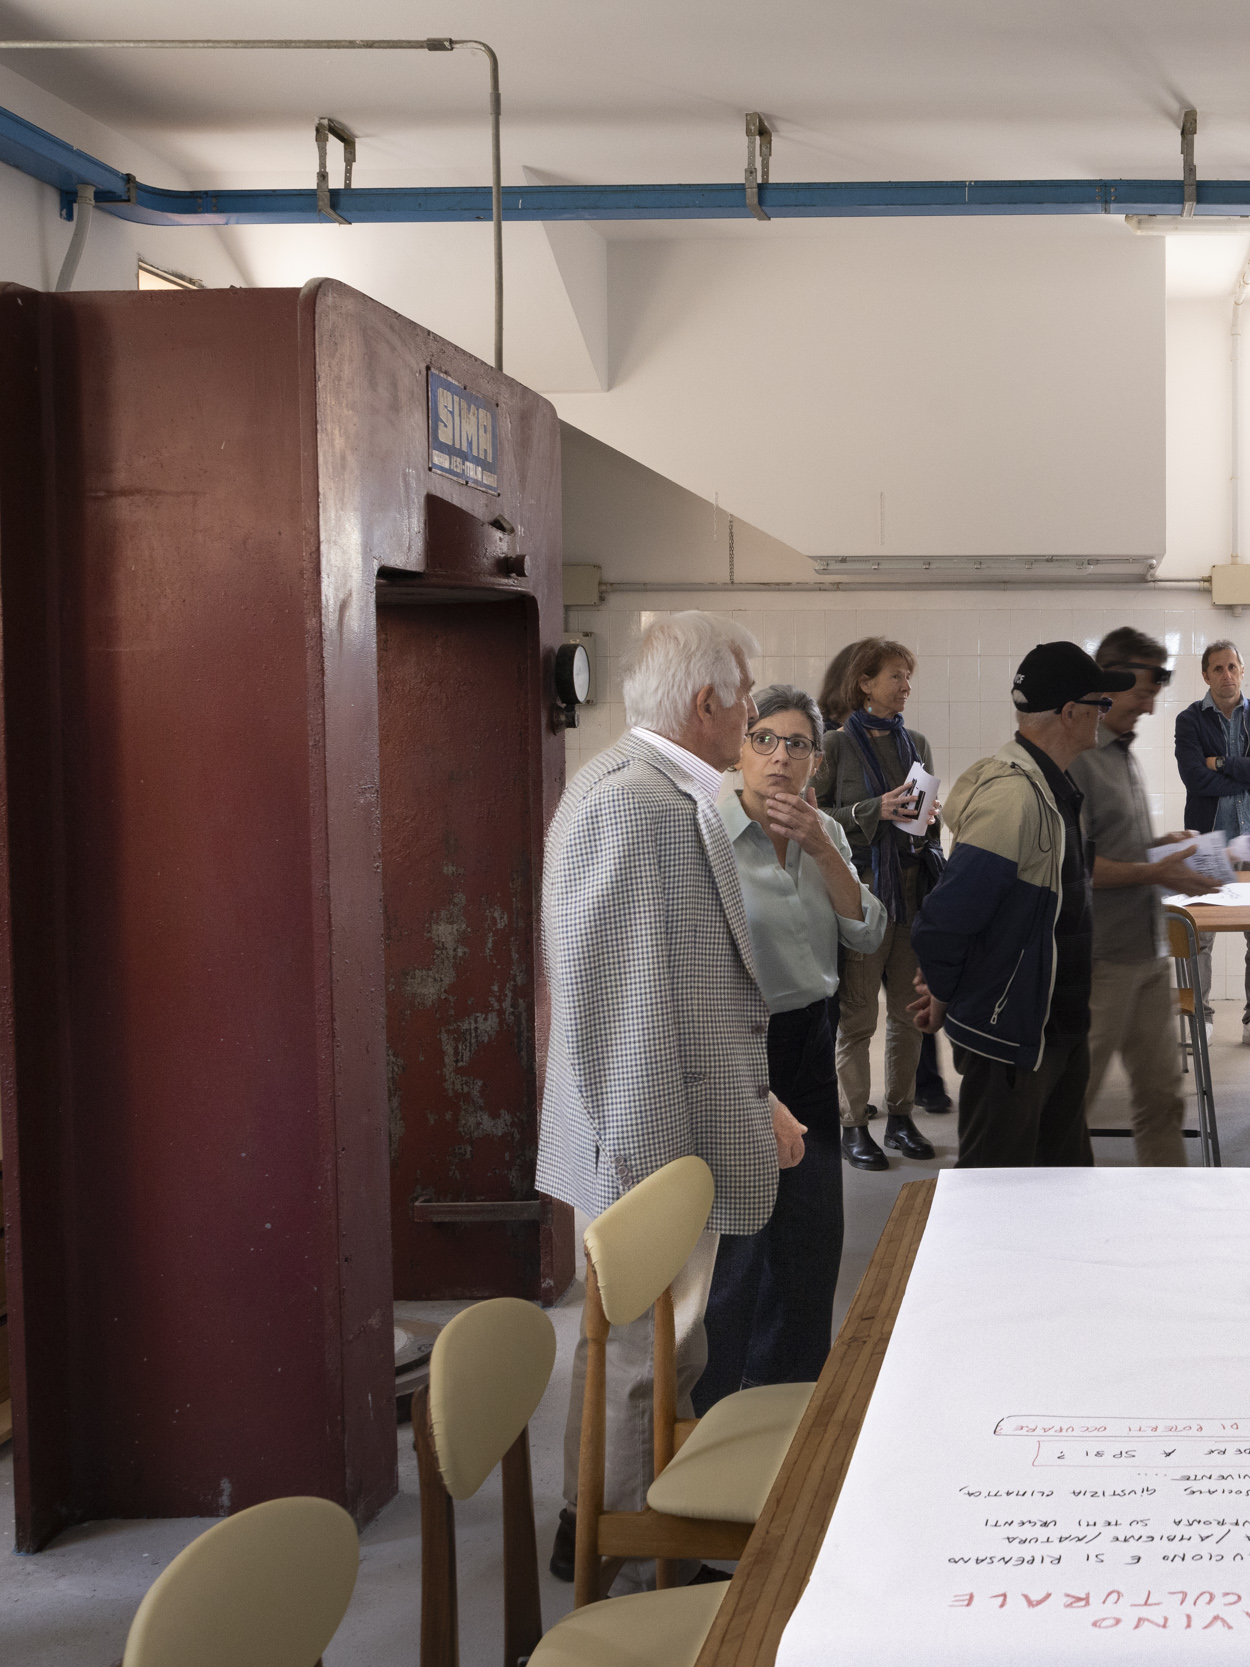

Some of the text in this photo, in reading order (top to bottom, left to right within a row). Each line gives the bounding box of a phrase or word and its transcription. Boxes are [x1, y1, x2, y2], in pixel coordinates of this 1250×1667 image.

[437, 387, 493, 463] SIMA
[1221, 1422, 1239, 1430] DI
[1162, 1449, 1176, 1458] A
[1172, 1473, 1250, 1481] VIVENTE
[1071, 1486, 1156, 1498] GIUSTIZIA
[985, 1519, 1057, 1528] URGENTI
[948, 1555, 1062, 1566] RIPENSANO
[1086, 1553, 1104, 1563] SI
[1125, 1555, 1142, 1565] E
[948, 1590, 1242, 1608] CULTURALE
